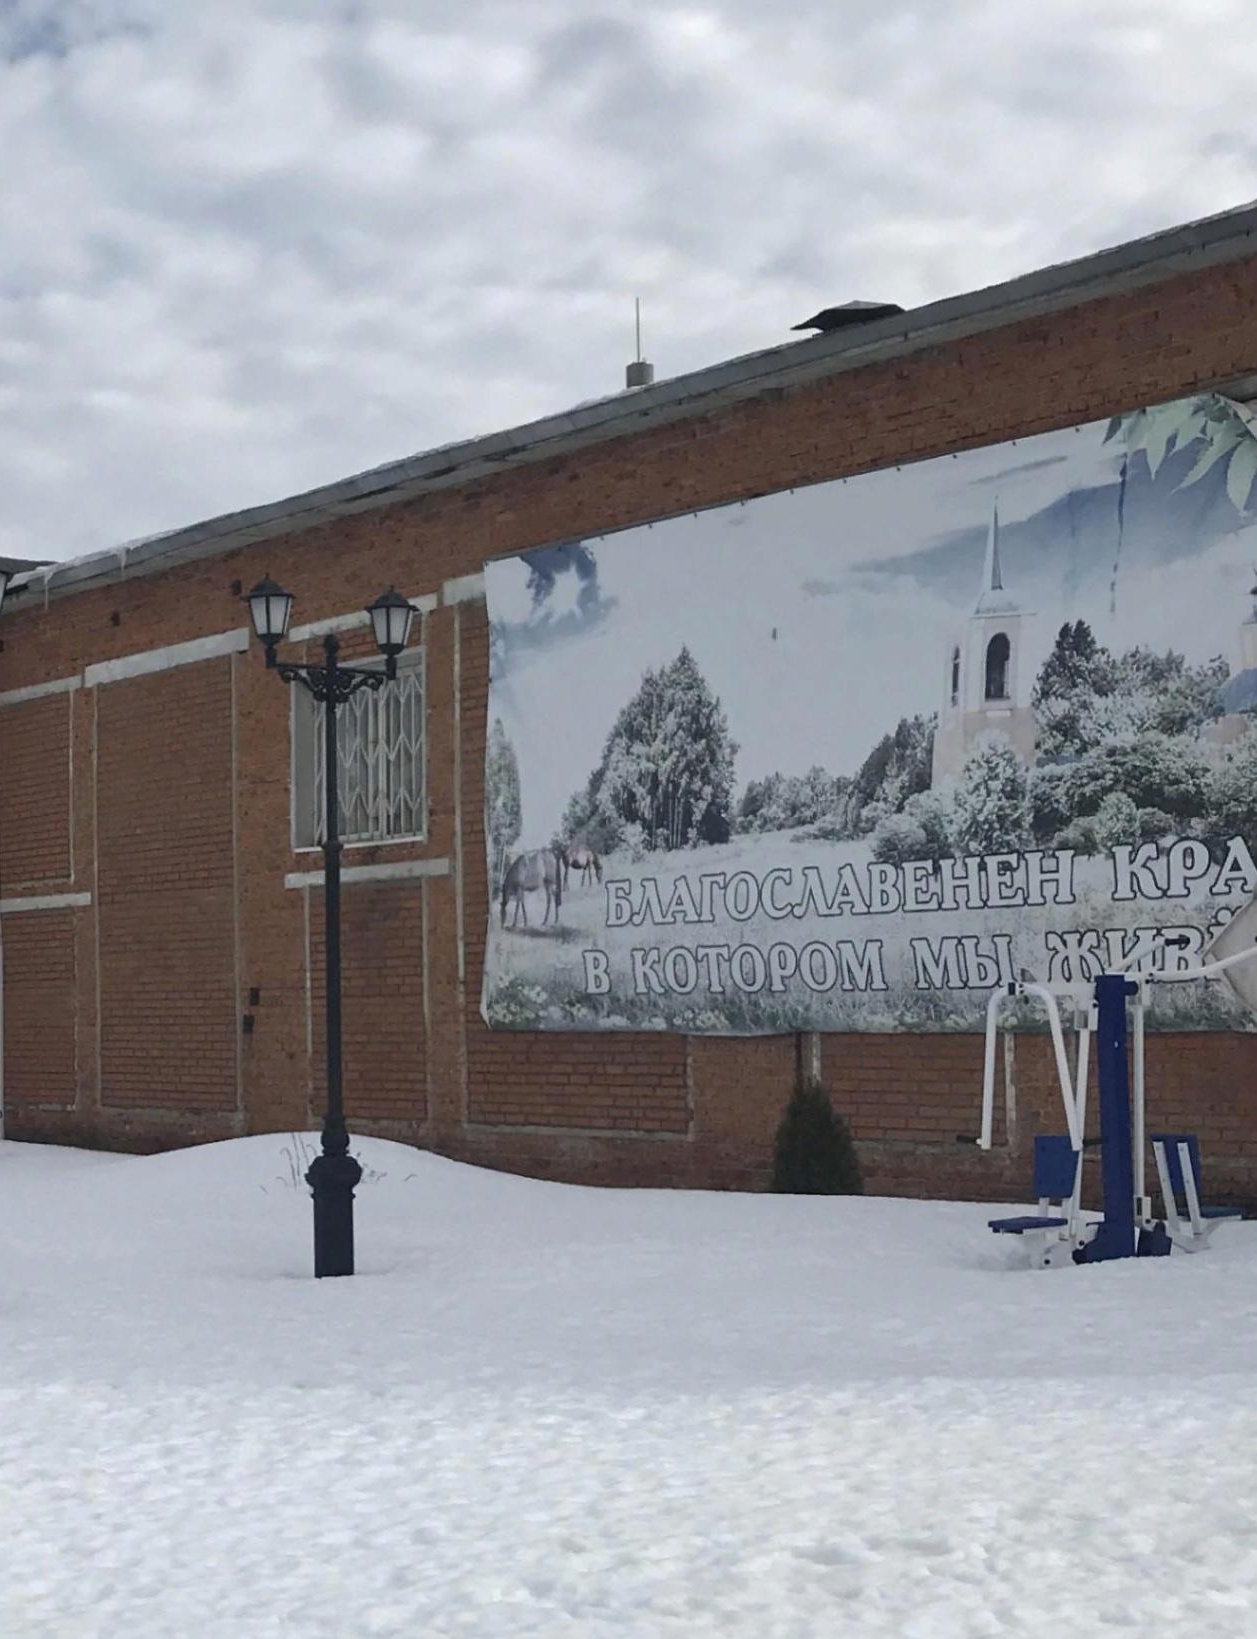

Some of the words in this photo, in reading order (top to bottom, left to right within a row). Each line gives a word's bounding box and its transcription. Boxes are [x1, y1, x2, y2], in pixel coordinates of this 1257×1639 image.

[605, 849, 1076, 927] БЛАГОСЛАВЕНЕН
[583, 949, 611, 995] В
[631, 939, 889, 995] КОТОРОМ
[910, 934, 1018, 990] МЫ
[1045, 906, 1246, 984] ЖИВ
